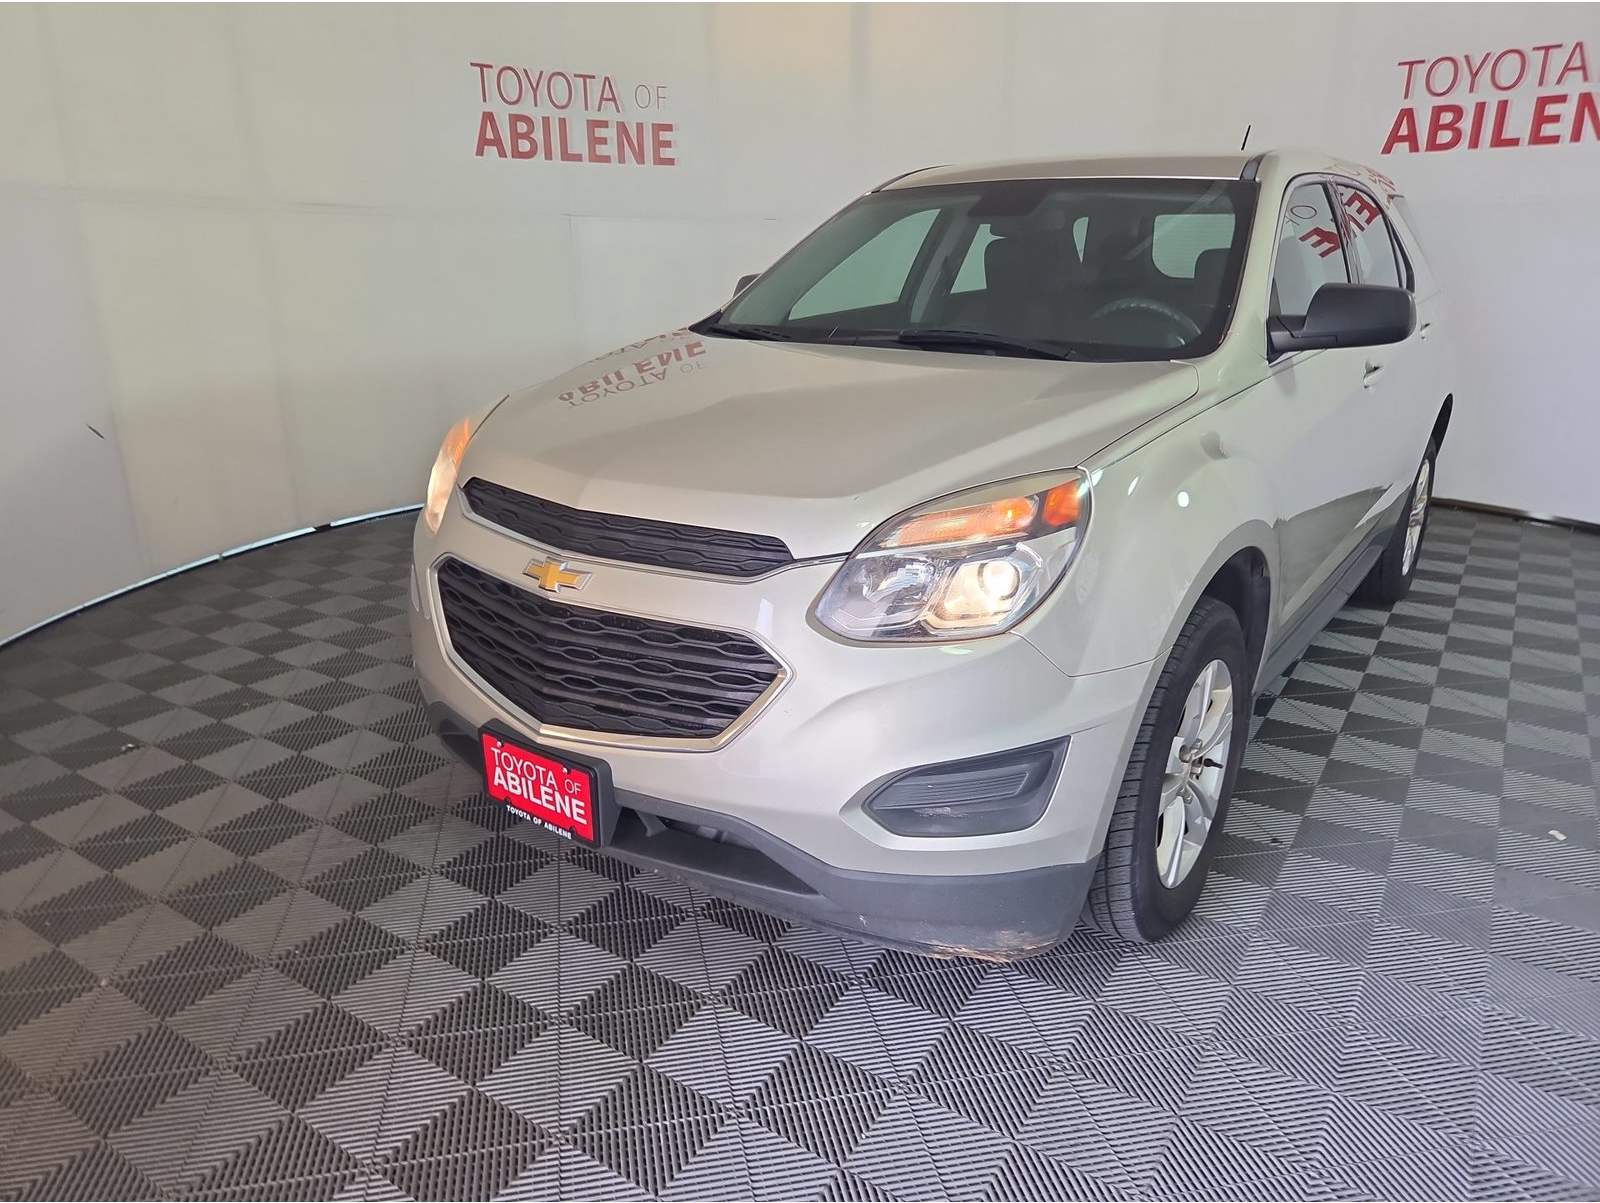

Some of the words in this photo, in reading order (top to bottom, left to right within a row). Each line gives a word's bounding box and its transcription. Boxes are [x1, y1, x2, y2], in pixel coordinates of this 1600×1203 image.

[469, 61, 621, 113] TOYOTA
[634, 84, 667, 110] OF
[1397, 41, 1589, 100] TOYOTA
[475, 111, 676, 166] ABILENE
[1380, 92, 1600, 155] ABILEN
[491, 746, 558, 791] TOYOTA
[564, 779, 582, 795] OF
[493, 767, 587, 825] ABILENE
[506, 804, 531, 821] TOYOTA
[533, 816, 542, 825] OF
[544, 821, 572, 840] ABILENE
